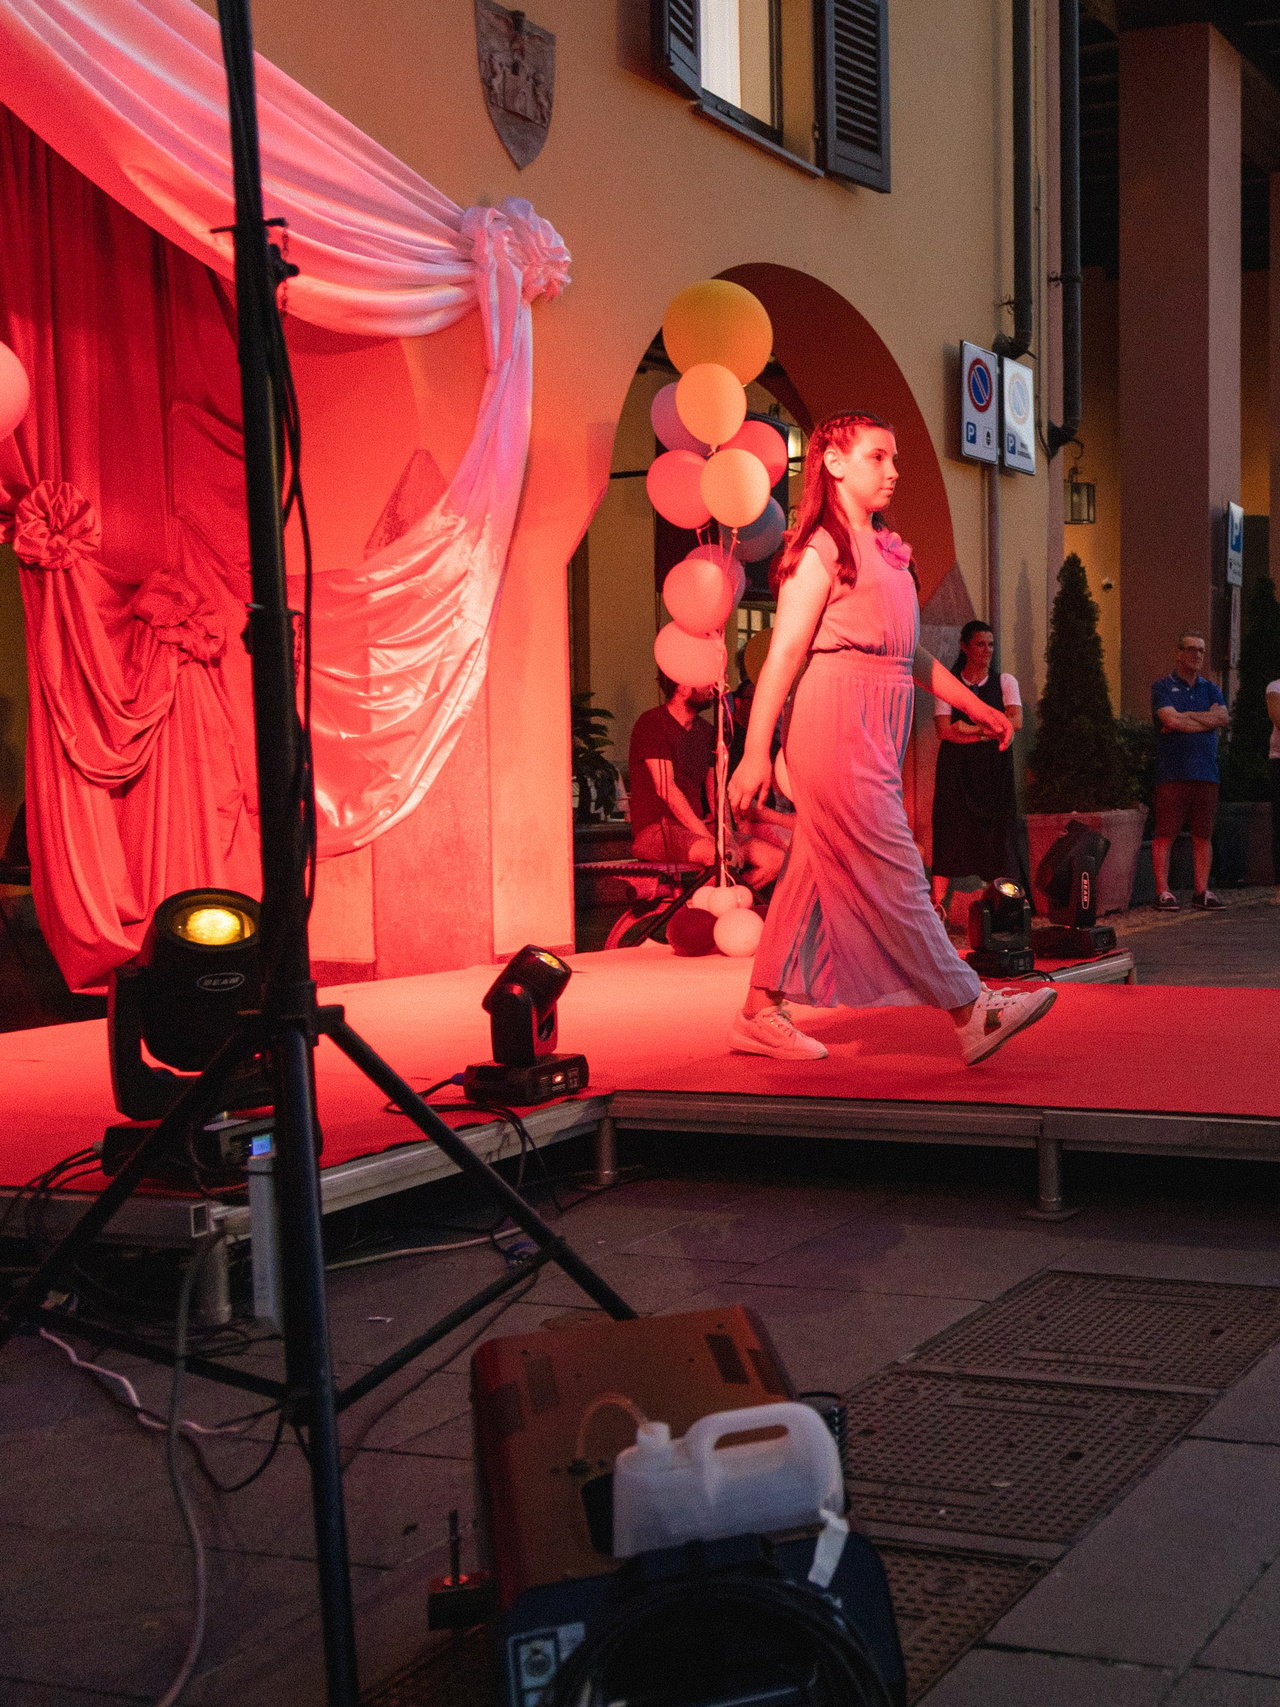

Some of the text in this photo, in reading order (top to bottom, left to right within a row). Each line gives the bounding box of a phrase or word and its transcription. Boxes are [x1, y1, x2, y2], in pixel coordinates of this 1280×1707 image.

[968, 425, 975, 440] P
[1008, 436, 1015, 451] P
[203, 976, 240, 986] BEAM
